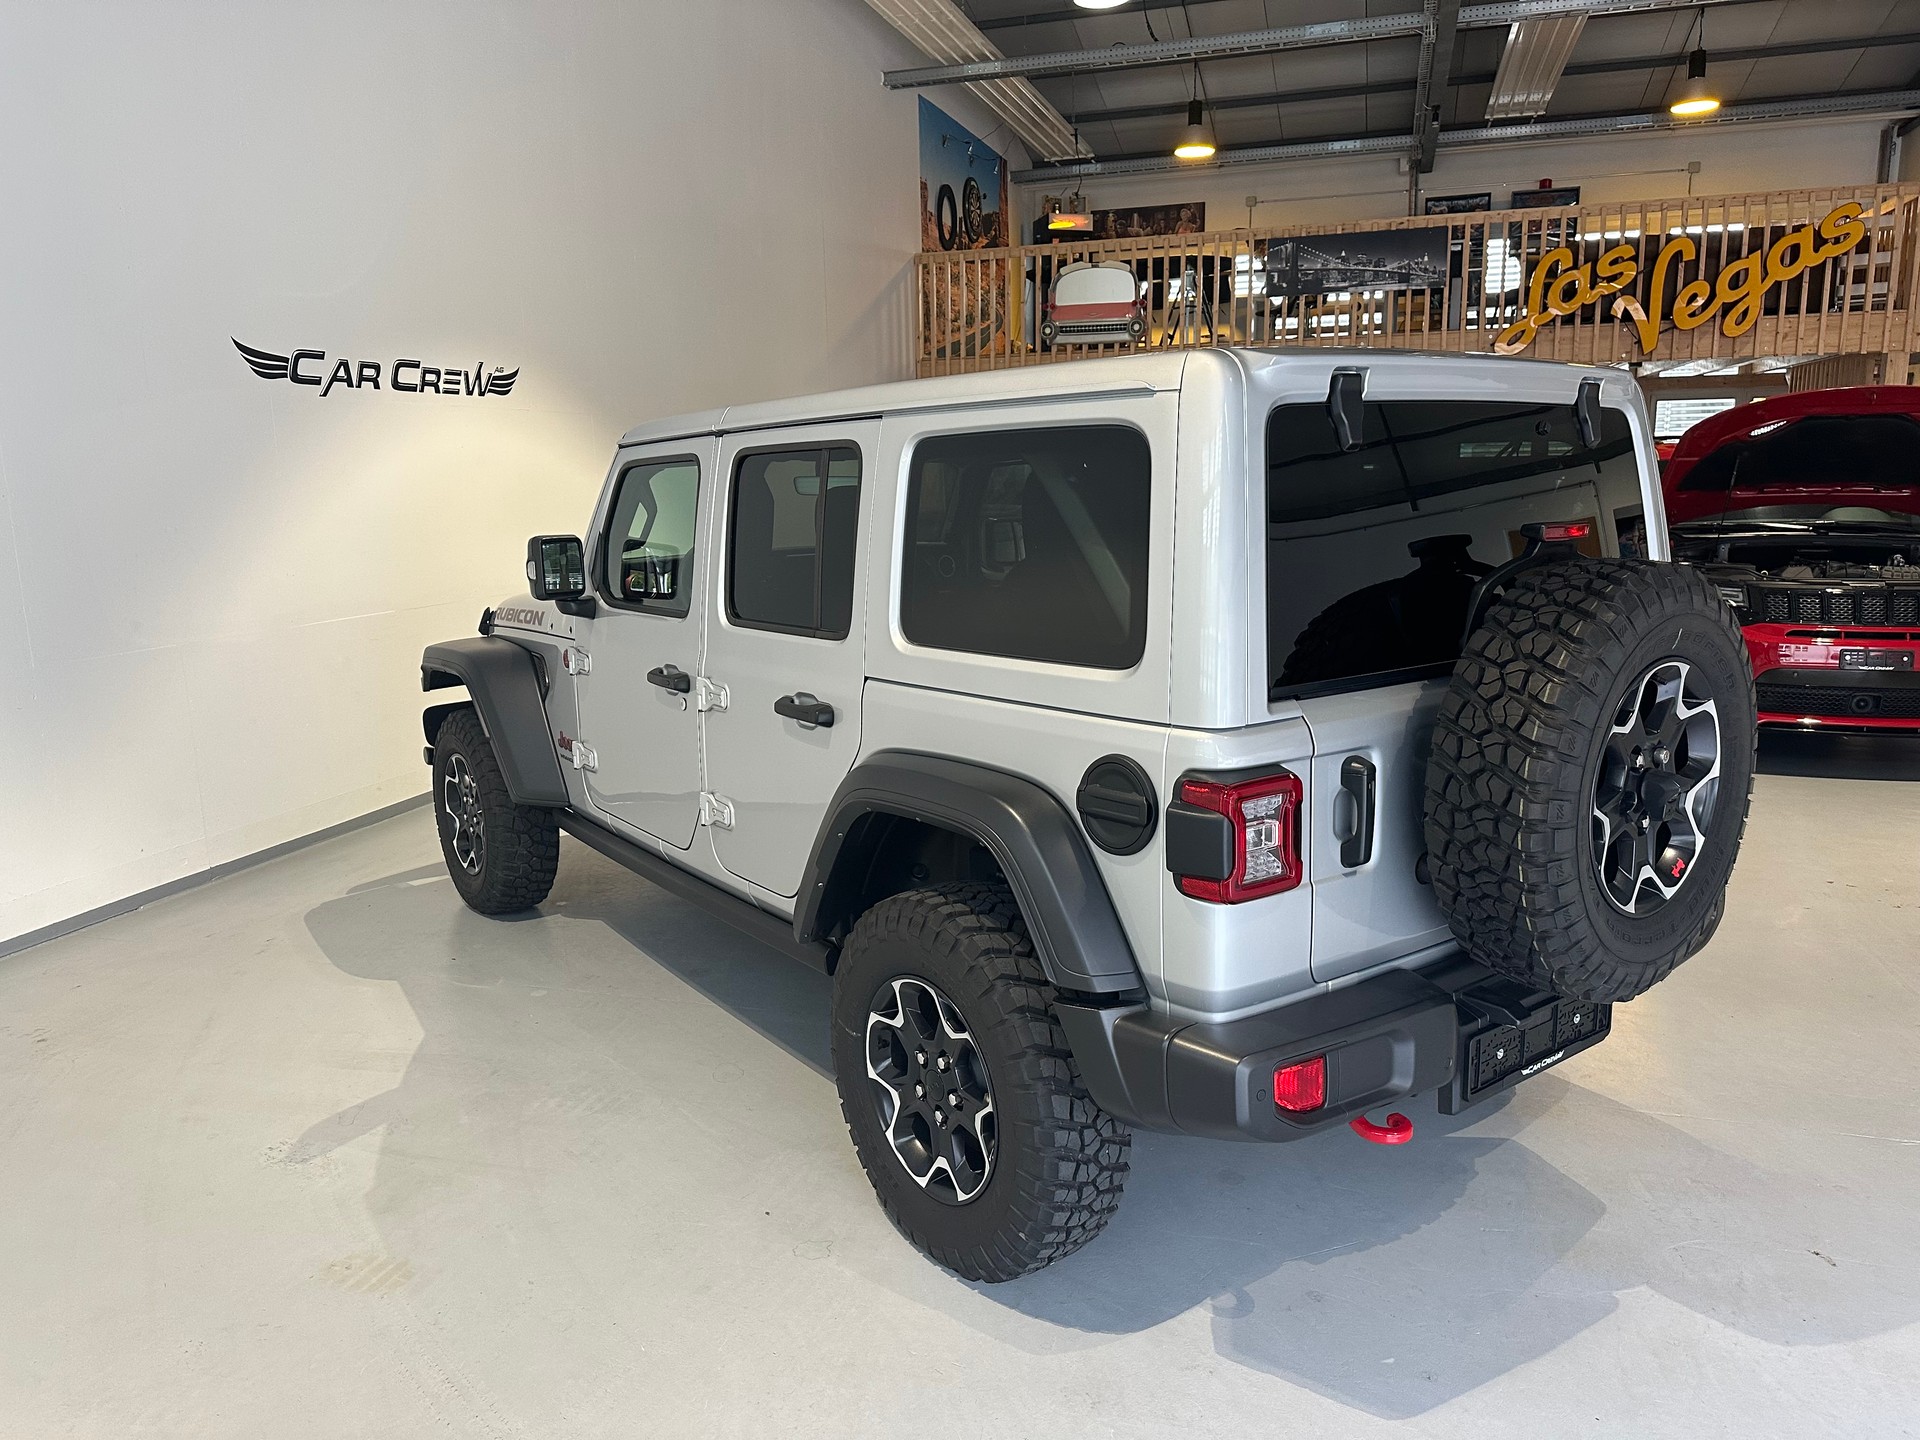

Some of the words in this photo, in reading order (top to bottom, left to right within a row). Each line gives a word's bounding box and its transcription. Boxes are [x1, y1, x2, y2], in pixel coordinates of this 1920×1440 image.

[1494, 243, 1638, 356] Las
[1610, 202, 1867, 355] Vegas
[288, 348, 382, 397] CAR
[390, 359, 493, 397] CREW
[495, 606, 546, 627] RUBICON
